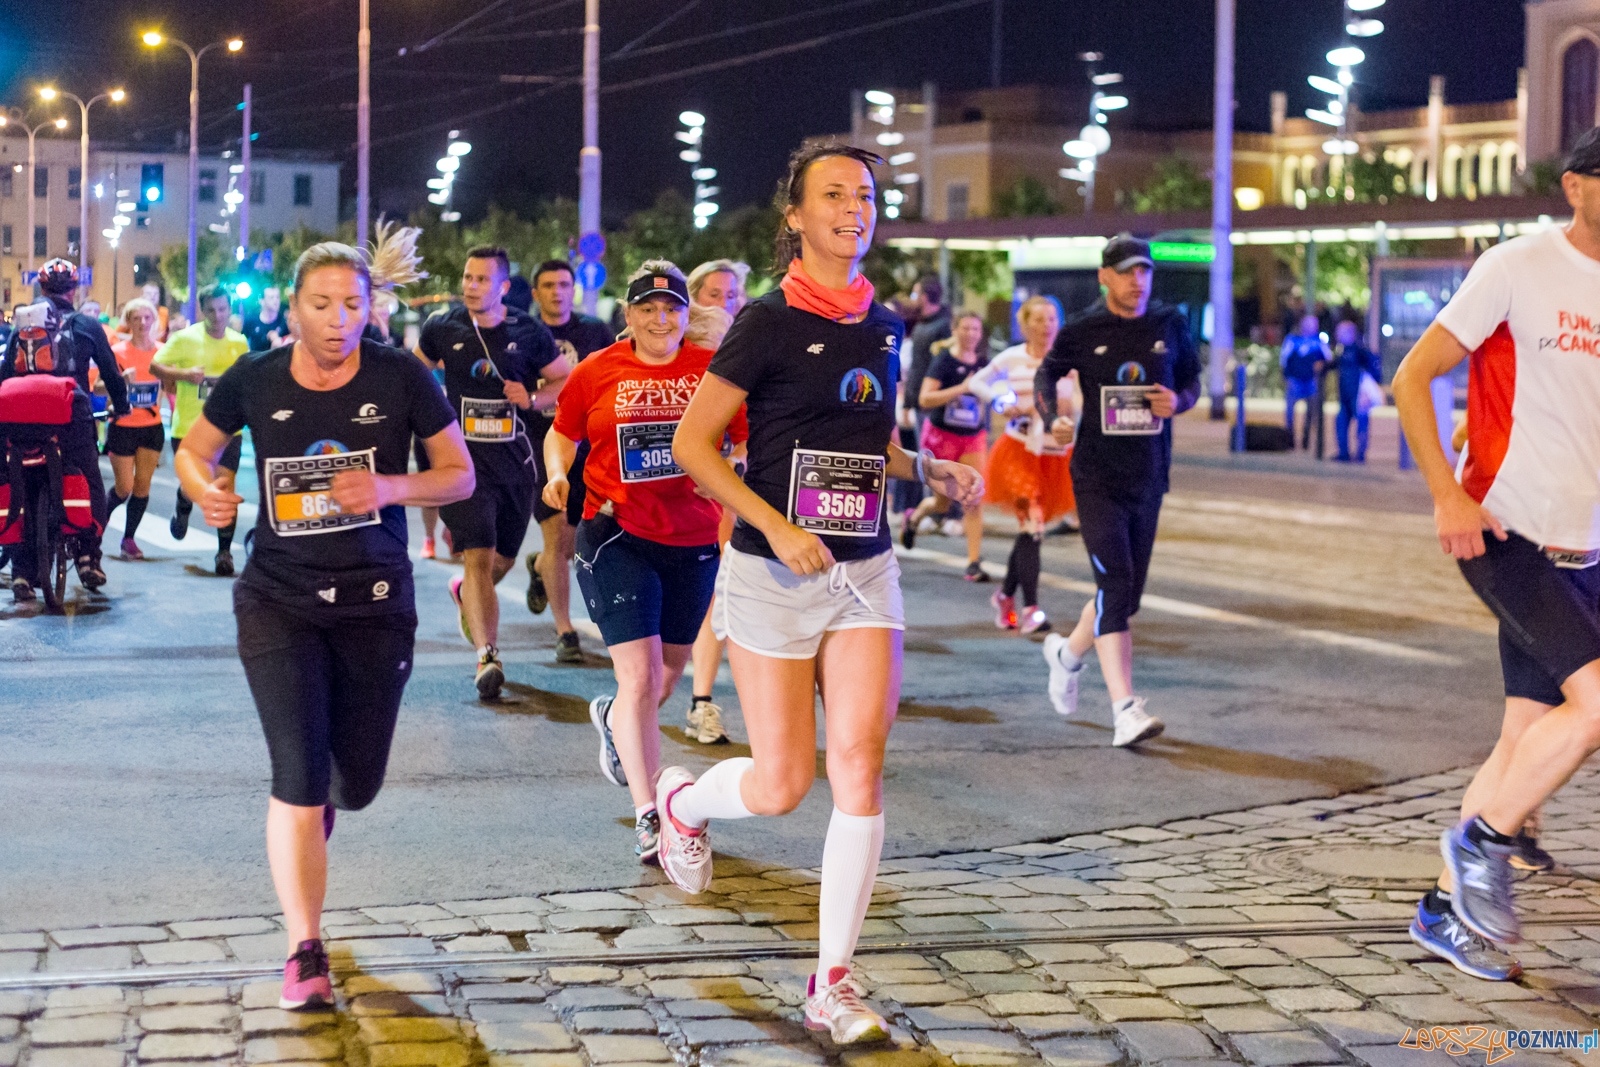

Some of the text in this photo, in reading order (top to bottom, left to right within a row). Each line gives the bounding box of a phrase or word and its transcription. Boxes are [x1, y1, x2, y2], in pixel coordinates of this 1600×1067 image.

[617, 377, 687, 393] DRUŻYNA
[616, 408, 686, 418] www.darszpik
[641, 449, 675, 468] 305
[817, 492, 866, 518] 3569
